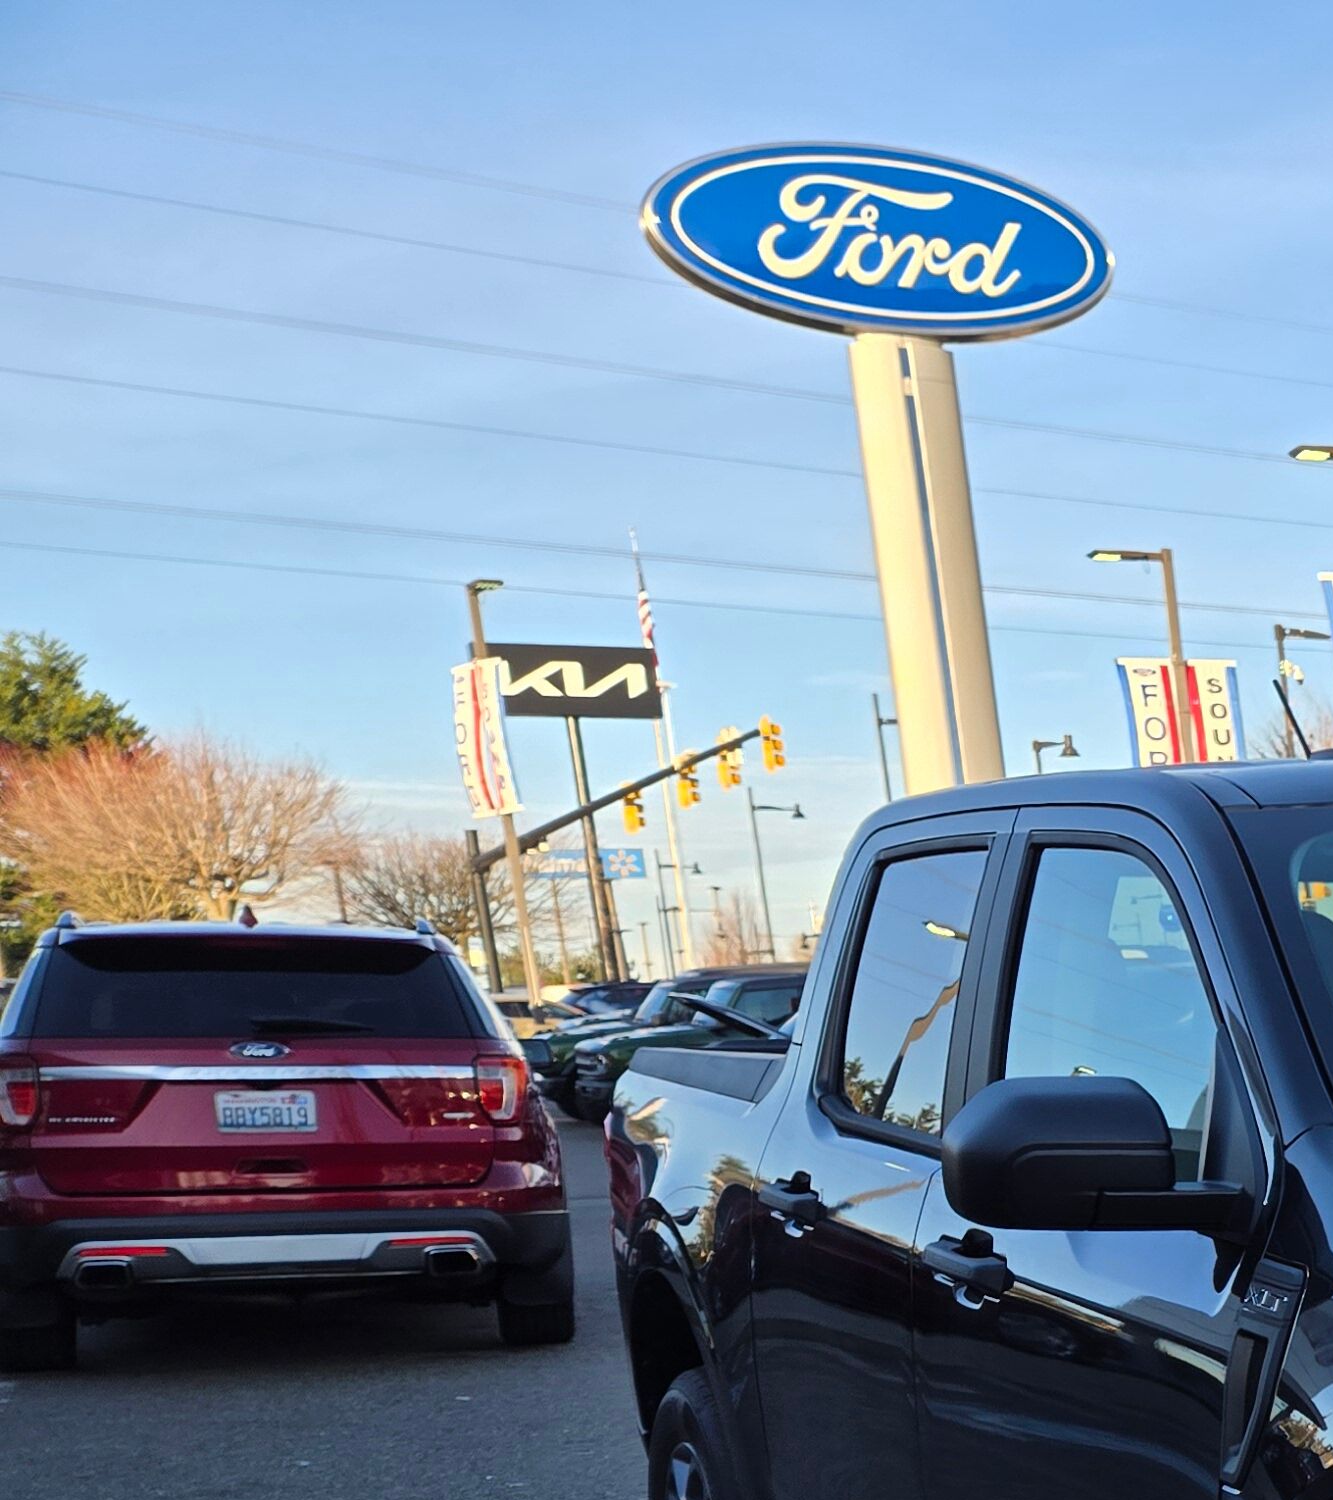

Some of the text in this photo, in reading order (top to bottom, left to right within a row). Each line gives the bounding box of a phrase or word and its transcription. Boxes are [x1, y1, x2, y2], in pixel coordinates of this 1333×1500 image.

[757, 173, 1021, 299] Ford
[1141, 684, 1169, 766] FOR
[1243, 1286, 1289, 1312] XLT
